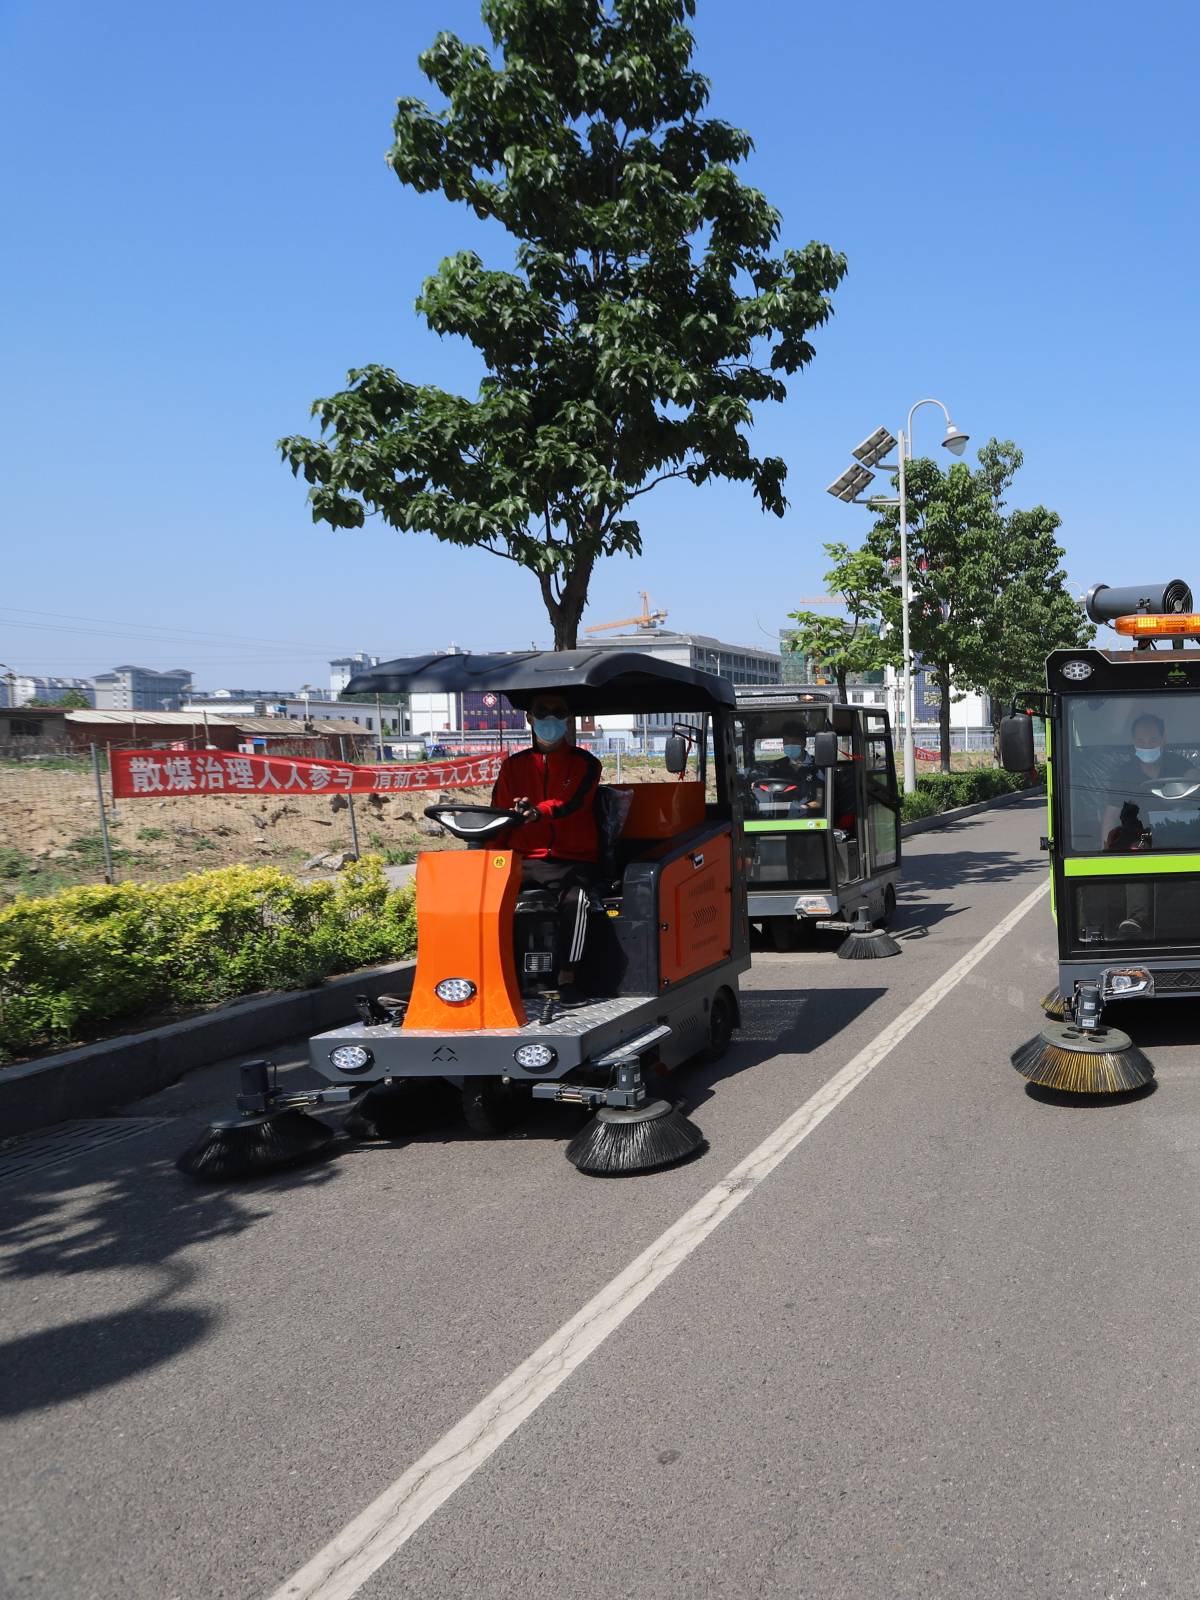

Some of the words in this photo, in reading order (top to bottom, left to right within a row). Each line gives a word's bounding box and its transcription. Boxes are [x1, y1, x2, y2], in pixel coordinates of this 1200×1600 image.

[129, 756, 354, 793] 散煤治理人人参与
